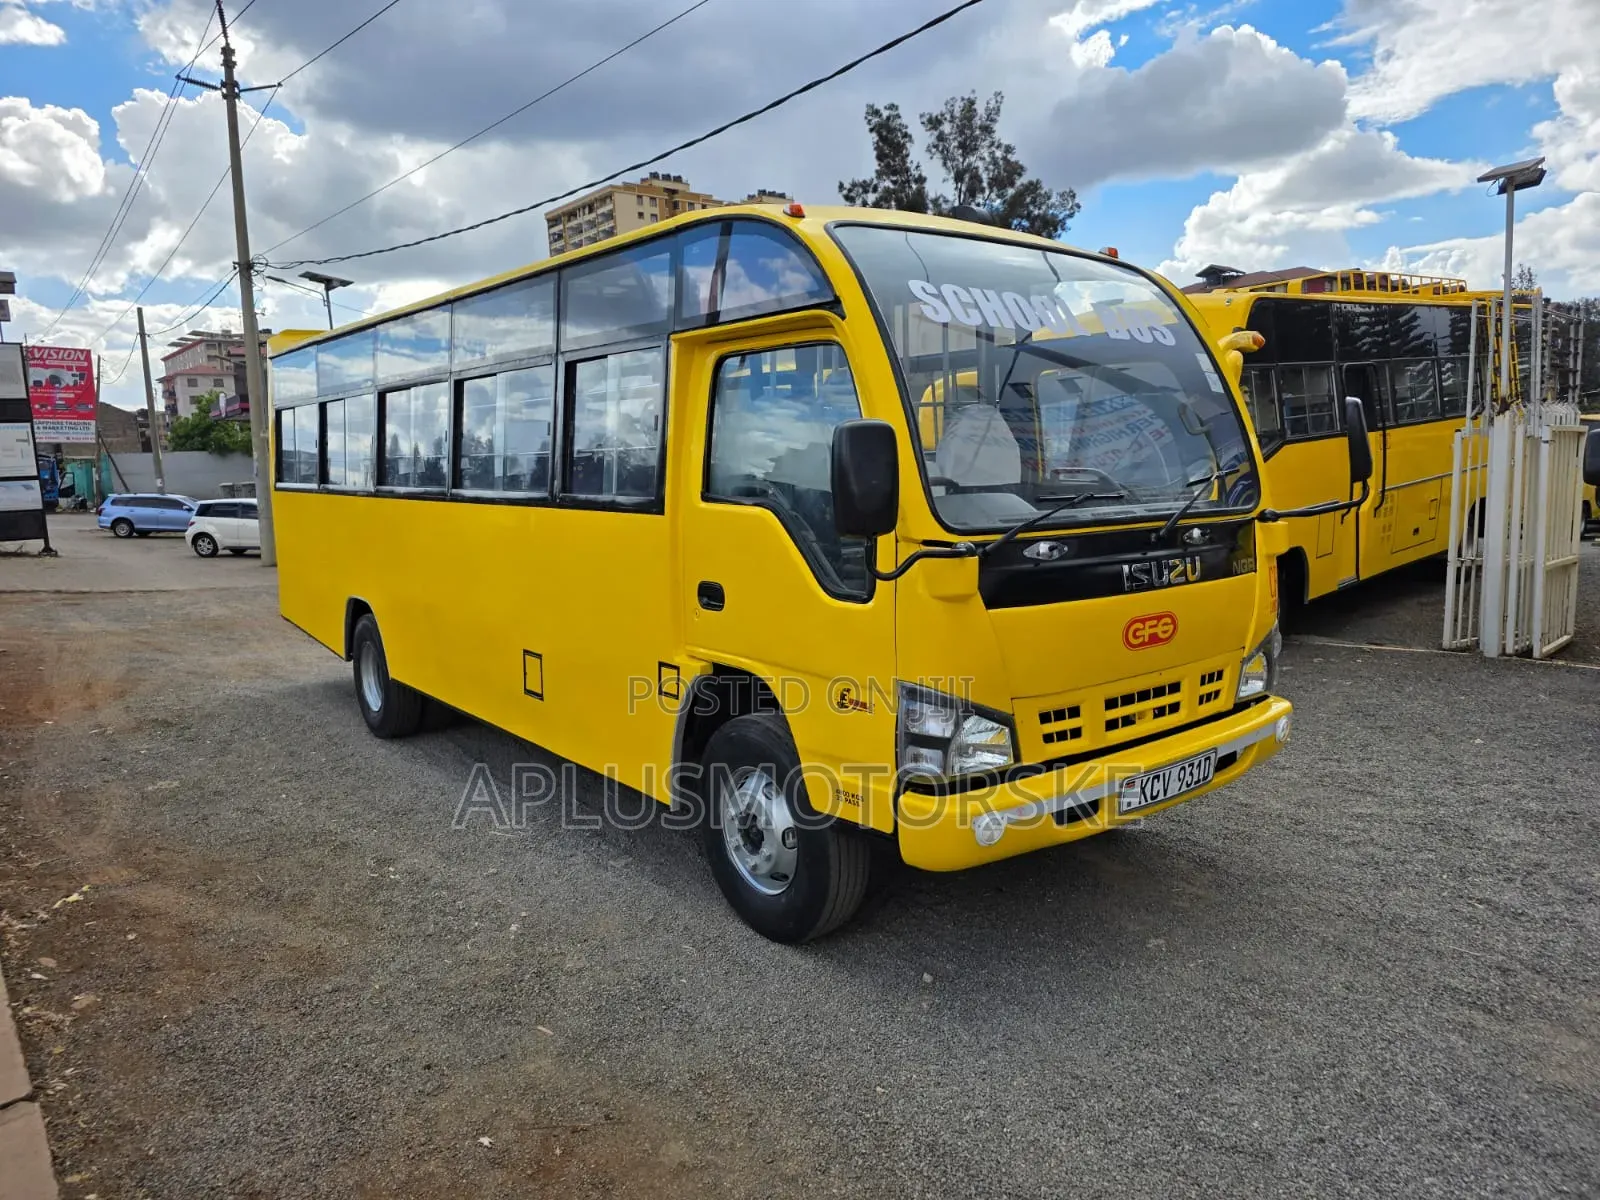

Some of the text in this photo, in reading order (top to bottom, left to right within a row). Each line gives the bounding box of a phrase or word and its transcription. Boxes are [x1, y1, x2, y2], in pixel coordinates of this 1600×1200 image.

[908, 280, 1176, 346] SCHOOL BUS
[1122, 556, 1201, 591] ISUZU
[1138, 756, 1211, 804] KCV 931D
